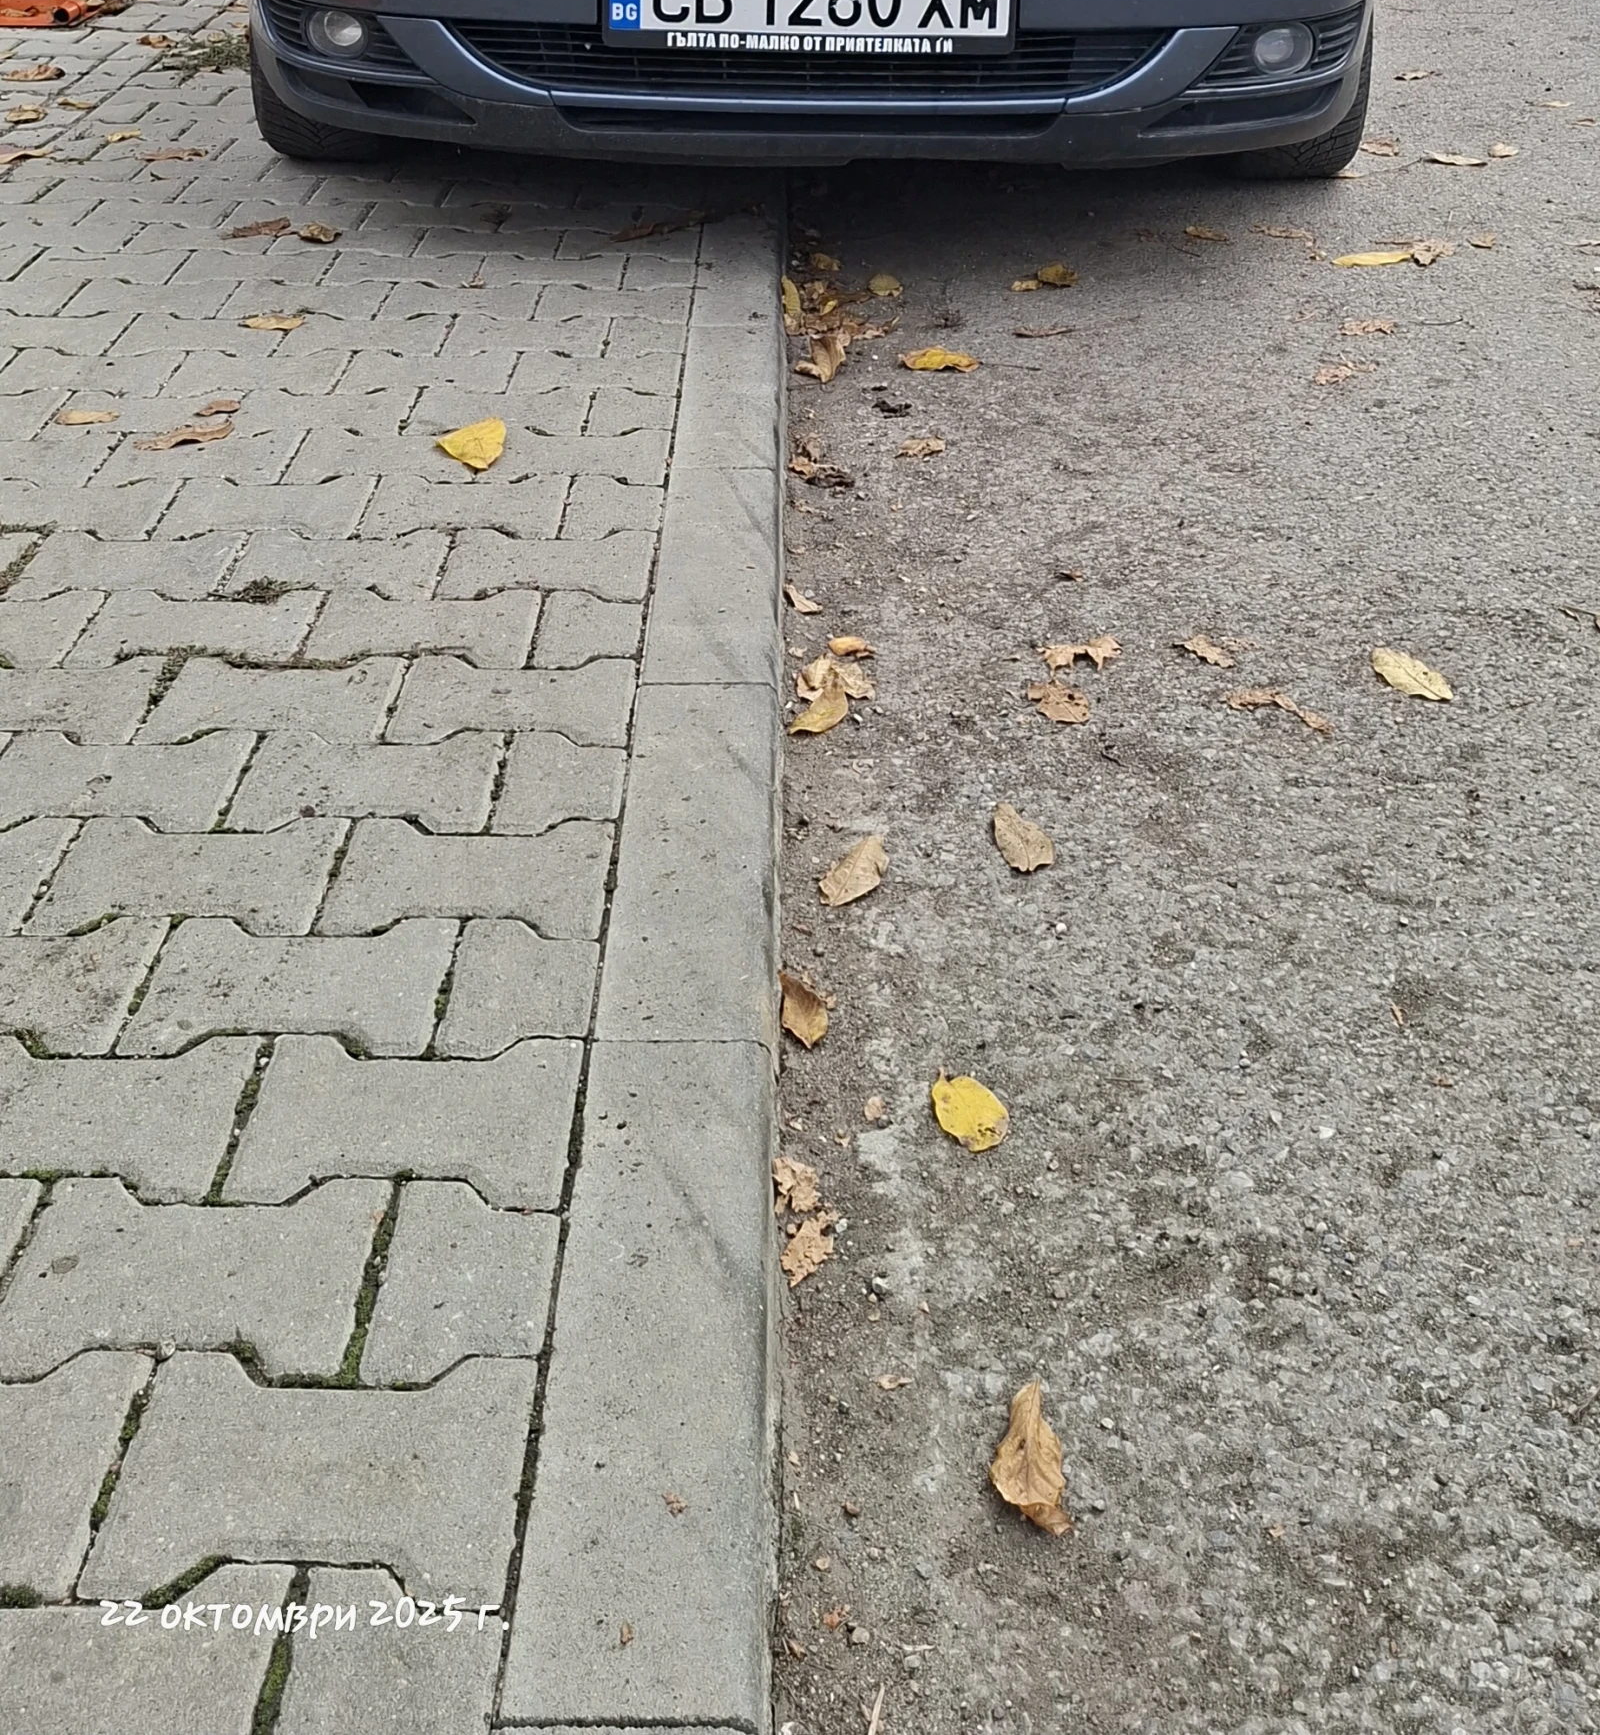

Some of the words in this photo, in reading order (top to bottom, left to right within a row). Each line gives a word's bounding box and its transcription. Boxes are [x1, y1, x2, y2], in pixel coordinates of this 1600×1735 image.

[612, 2, 637, 21] BG
[667, 31, 716, 48] ГЪЛТА
[719, 33, 800, 51] ПО-МАЛКО
[803, 36, 822, 51] ОТ
[825, 37, 931, 53] ПРИЯТЕЛКАТА
